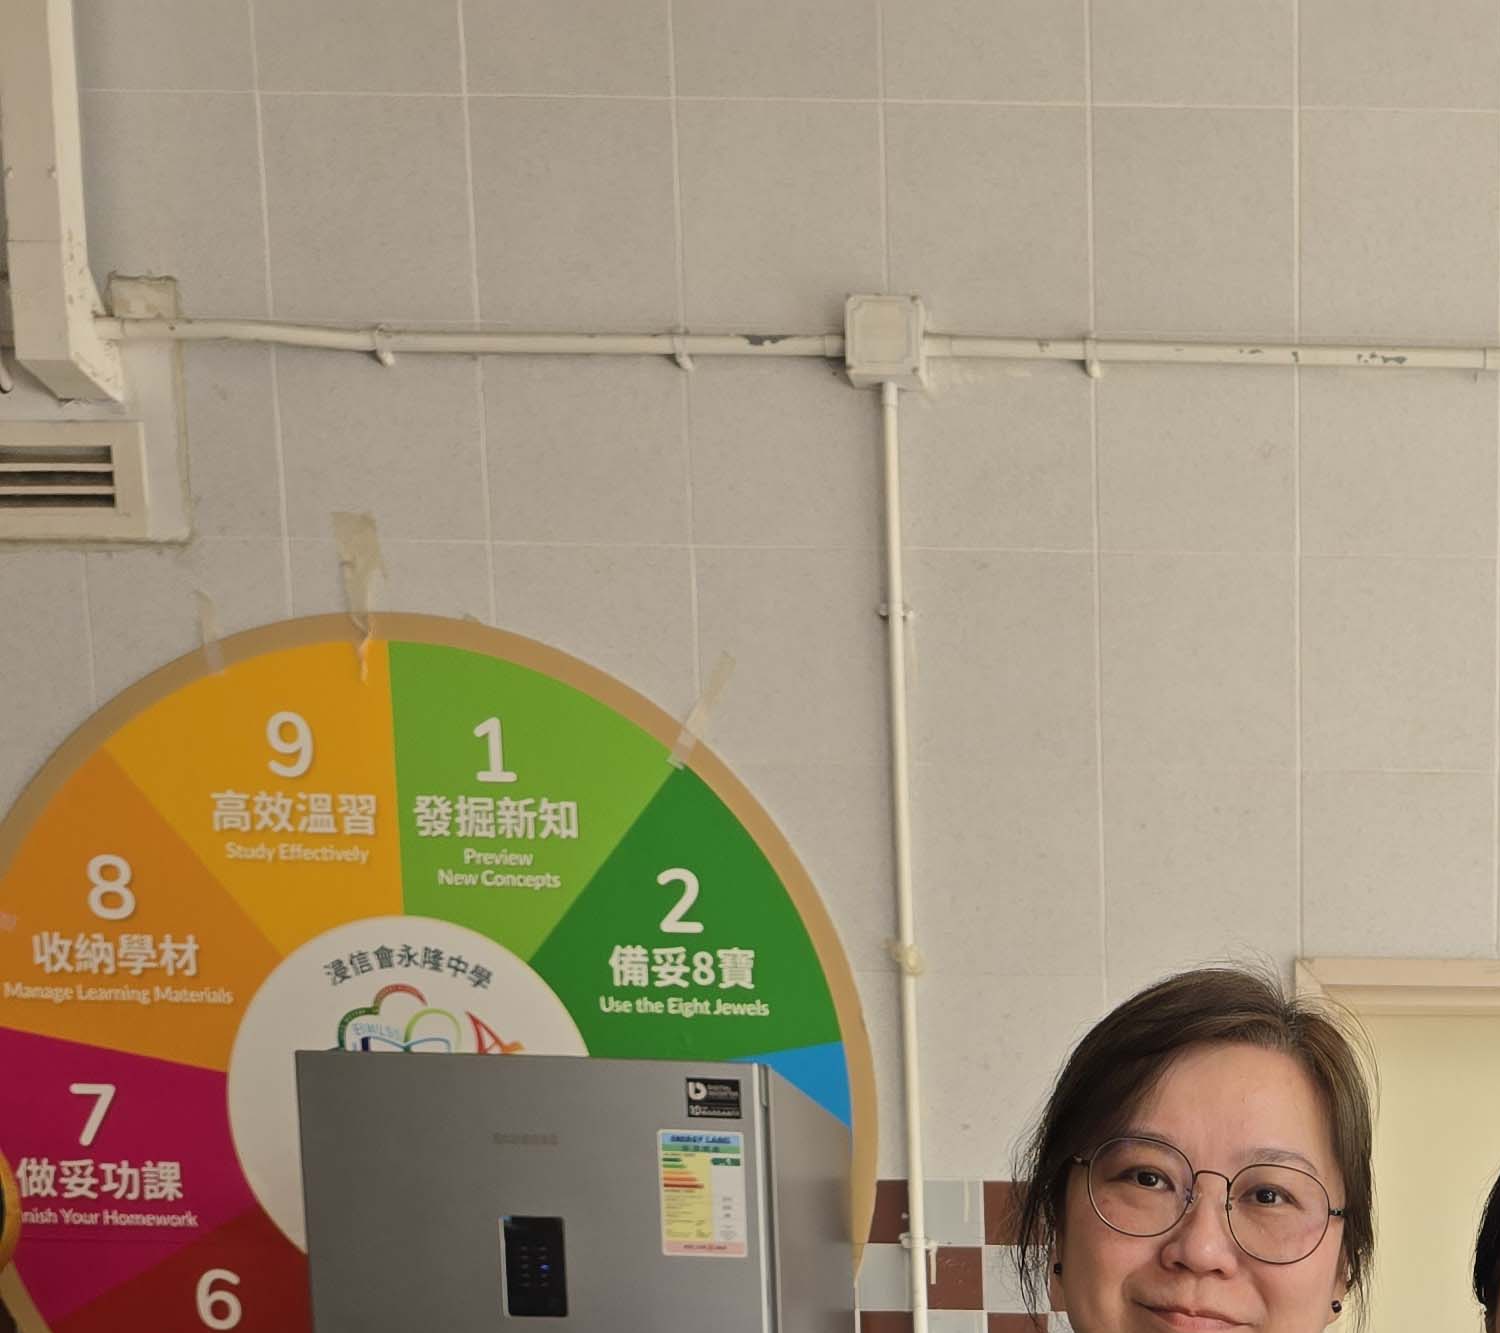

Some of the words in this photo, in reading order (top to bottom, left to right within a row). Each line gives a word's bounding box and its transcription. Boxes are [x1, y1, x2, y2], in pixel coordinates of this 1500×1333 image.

[266, 711, 314, 777] 9
[473, 717, 517, 783] 1
[210, 789, 377, 836] 高效溫習
[413, 794, 579, 839] 發掘新知
[225, 842, 274, 863] Study
[279, 844, 369, 864] Effectively
[464, 848, 533, 867] Preview
[87, 854, 136, 920] 8
[438, 869, 477, 886] New
[481, 870, 561, 890] Concepts
[657, 867, 704, 933] 2
[32, 931, 199, 976] 收納學材
[323, 944, 493, 989] 浸信會永隆中學
[609, 944, 755, 989] 備妥8寶
[3, 982, 73, 1003] Manage
[77, 984, 150, 1004] Learning
[154, 986, 234, 1004] Materials
[599, 995, 632, 1013] Use
[636, 997, 664, 1013] the
[667, 997, 711, 1018] Eight
[713, 999, 770, 1016] Jewels
[69, 1083, 116, 1146] 7
[16, 1157, 184, 1201] 做妥功課
[22, 1208, 58, 1223] nish
[60, 1208, 100, 1224] Your
[103, 1209, 199, 1227] Homework
[196, 1268, 242, 1330] 6
